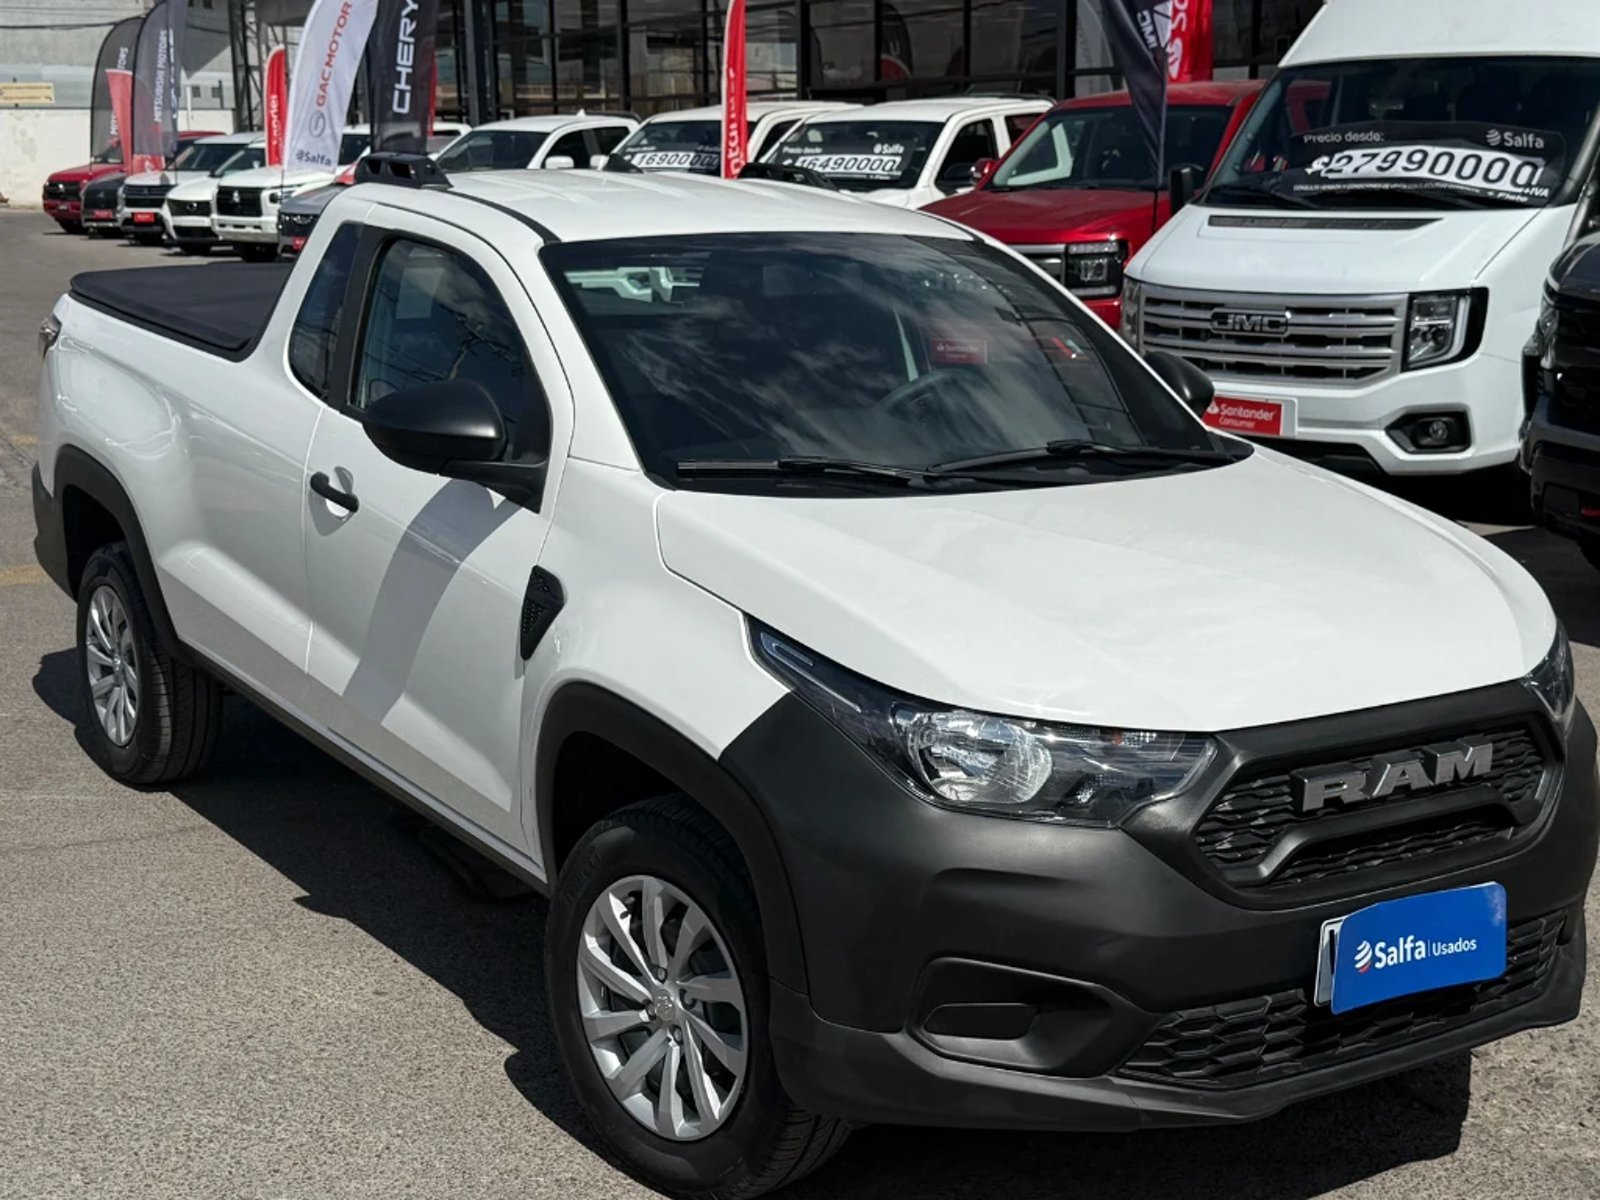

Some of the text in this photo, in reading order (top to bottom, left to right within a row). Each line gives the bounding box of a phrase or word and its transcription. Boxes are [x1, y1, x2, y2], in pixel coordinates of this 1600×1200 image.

[316, 2, 353, 107] GAC MOTOR
[393, 0, 419, 114] CHERY
[1303, 132, 1342, 144] Precio
[1504, 132, 1545, 149] Salfa
[304, 150, 332, 166] Salfa
[1213, 313, 1287, 332] JMC
[1220, 403, 1276, 421] Santander
[1219, 416, 1256, 429] Consumer
[1300, 740, 1494, 813] RAM
[1374, 935, 1478, 971] Salfa Usados
